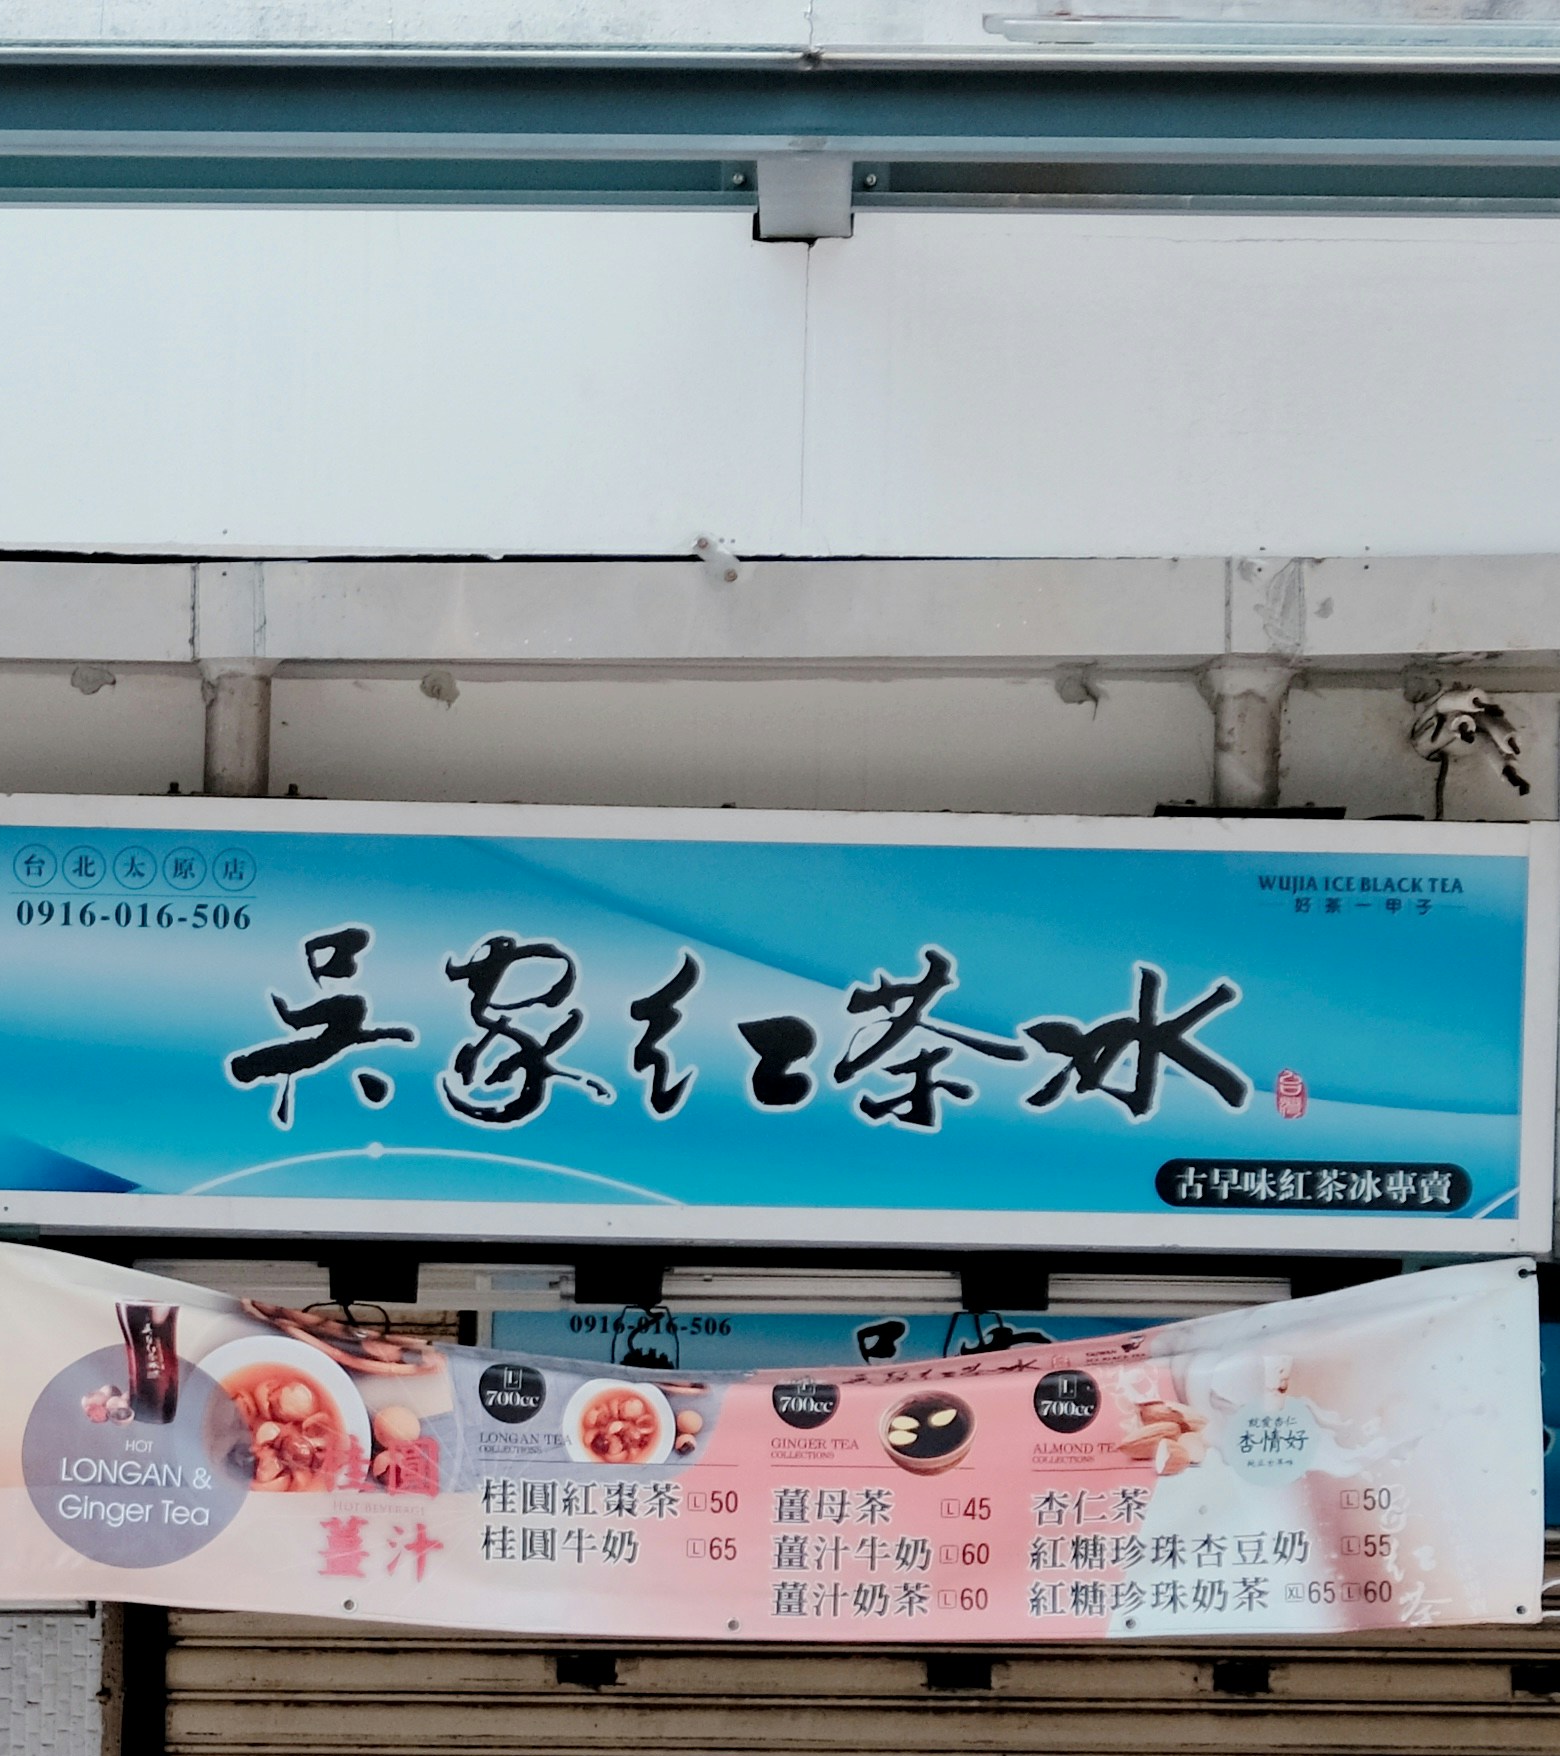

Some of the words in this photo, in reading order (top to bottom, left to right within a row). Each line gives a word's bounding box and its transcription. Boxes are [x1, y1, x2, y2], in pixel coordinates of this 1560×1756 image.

[18, 848, 252, 887] 台北太原店
[1259, 875, 1317, 893] WUJIA
[1324, 877, 1356, 892] ICE
[1360, 877, 1423, 893] BLACK
[1428, 878, 1464, 893] TEA
[16, 900, 251, 929] 0916-016-506
[1176, 1167, 1452, 1204] 古早味紅茶冰專賣
[485, 1390, 540, 1408] 700cc
[780, 1396, 834, 1415] 700cc
[1041, 1400, 1095, 1418] 700cc
[125, 1440, 152, 1453] HOT
[480, 1432, 542, 1446] LONGAN
[544, 1433, 573, 1446] TEA
[771, 1438, 827, 1450] GINGER
[831, 1439, 859, 1451] TEA
[1033, 1443, 1094, 1455] ALMOND
[1098, 1442, 1121, 1455] TE
[1238, 1428, 1309, 1453] 杏情好
[61, 1457, 181, 1487] LONGAN
[192, 1468, 212, 1490] &
[58, 1494, 152, 1526] Ginger
[161, 1499, 210, 1526] Tea
[480, 1478, 682, 1519] 桂圓紅棗茶
[709, 1489, 739, 1515] 50
[771, 1488, 893, 1526] 薑母茶
[962, 1496, 992, 1522] 45
[1032, 1488, 1149, 1526] 杏仁茶
[1363, 1487, 1392, 1511] 50
[317, 1515, 444, 1583] 薑汁
[480, 1525, 639, 1564] 桂圓牛奶
[708, 1536, 738, 1562] 65
[771, 1536, 932, 1573] 薑汁牛奶
[961, 1541, 991, 1567] 60
[1029, 1530, 1311, 1571] 紅糖珍珠杏豆奶
[1363, 1534, 1392, 1557] 55
[771, 1582, 932, 1620] 薑汁奶茶
[960, 1588, 989, 1612] 60
[1029, 1576, 1269, 1618] 紅糖珍珠奶茶
[1307, 1581, 1336, 1605] 65
[1363, 1580, 1393, 1604] 60
